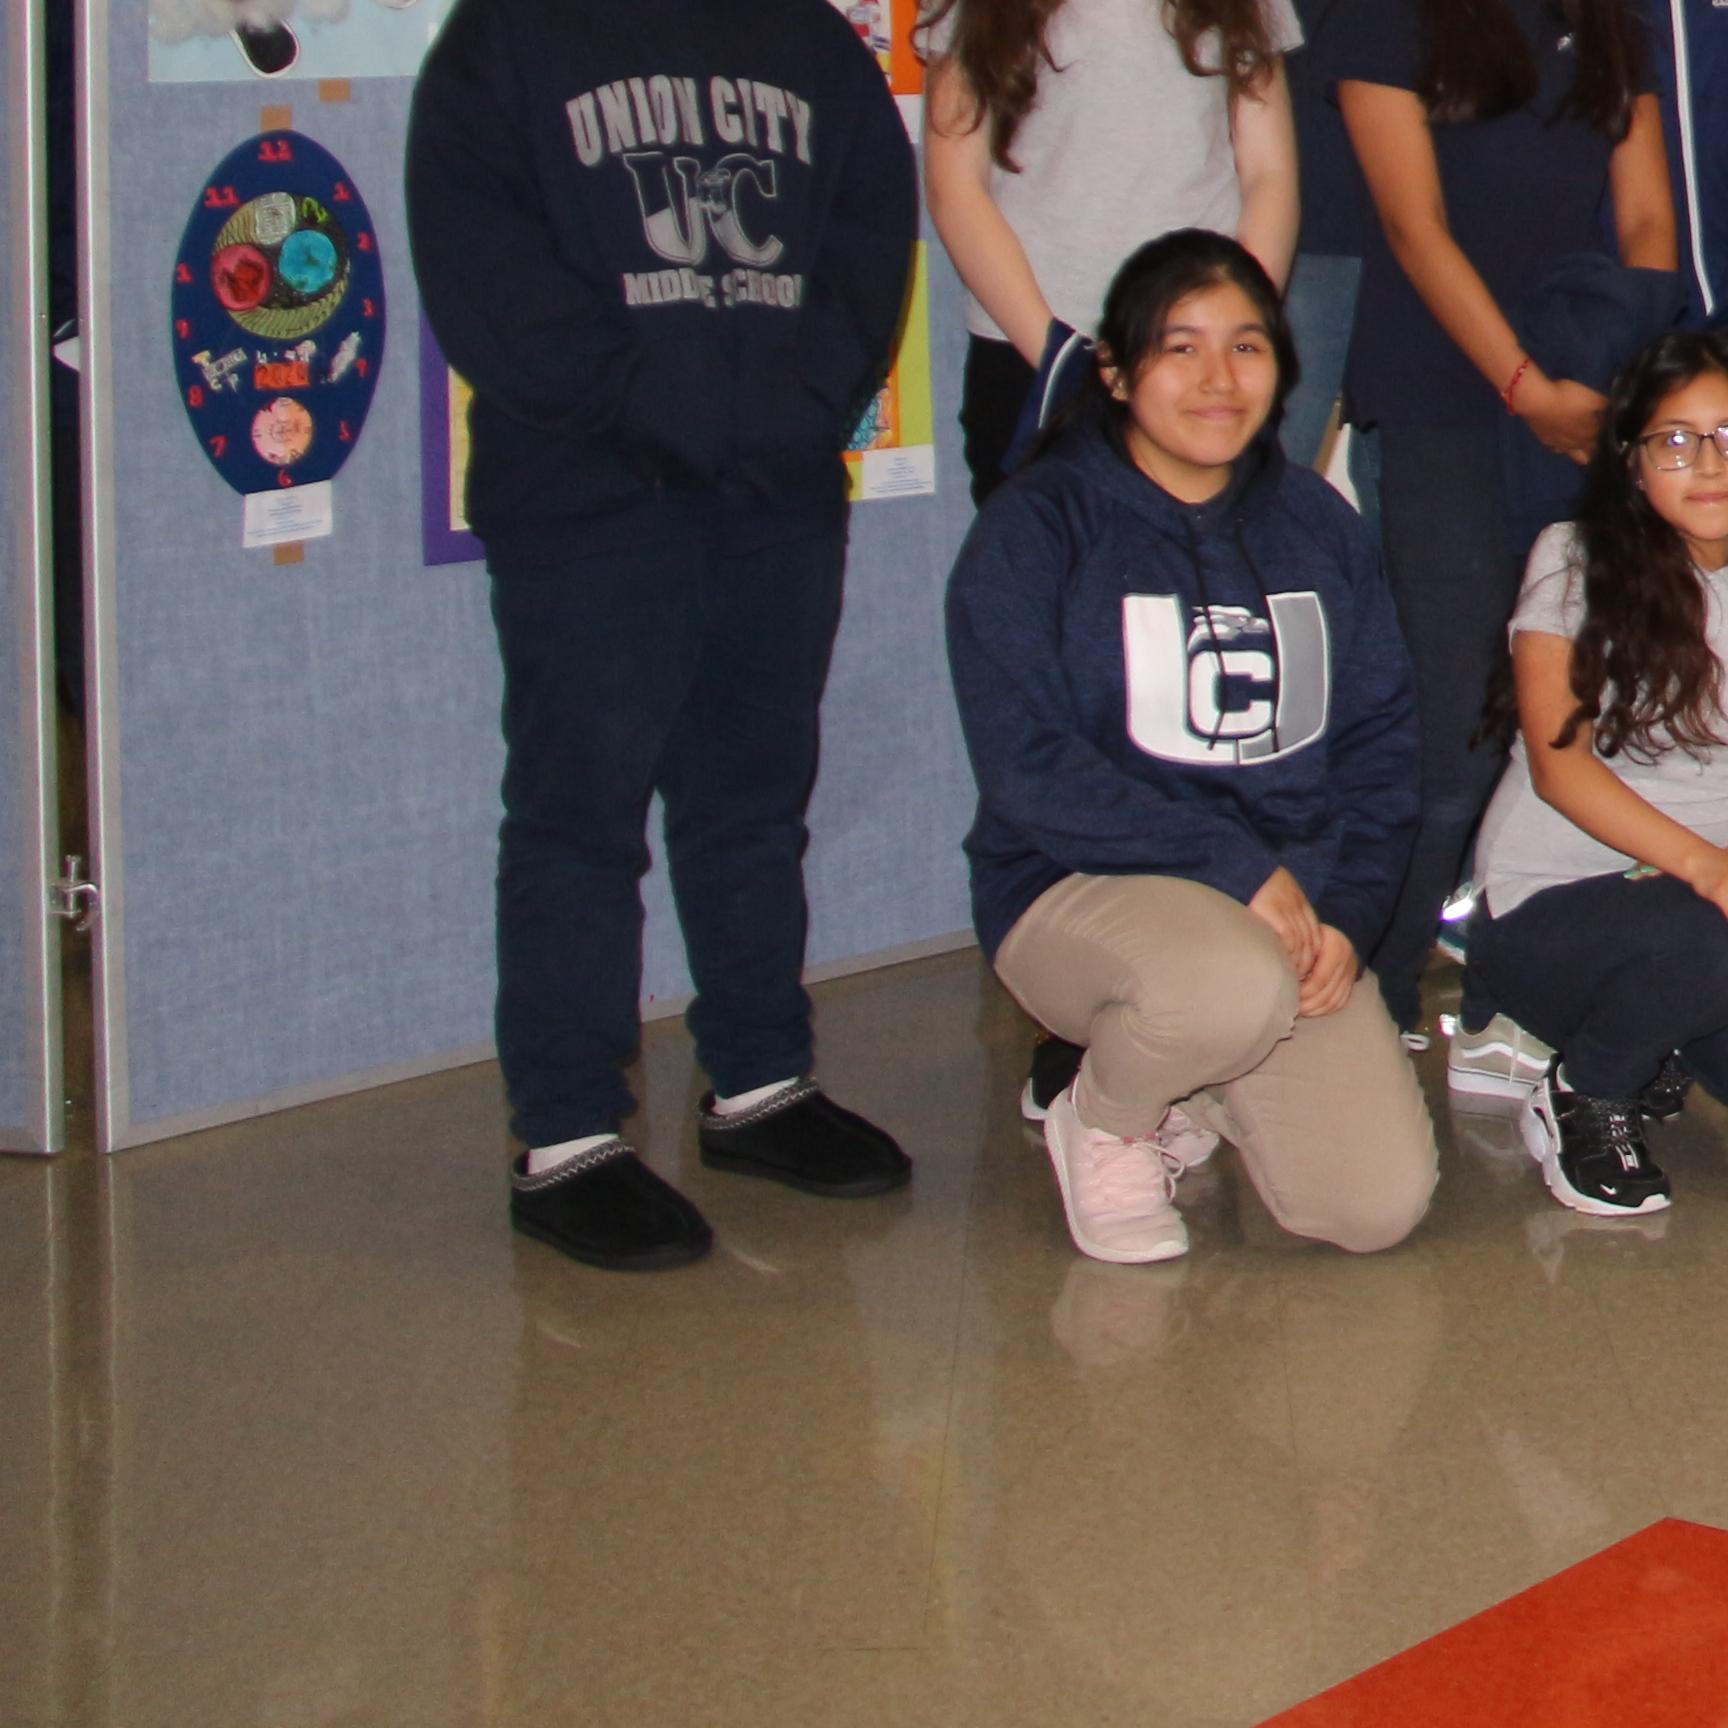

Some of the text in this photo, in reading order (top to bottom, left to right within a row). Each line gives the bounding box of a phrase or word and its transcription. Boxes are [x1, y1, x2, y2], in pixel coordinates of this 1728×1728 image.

[565, 73, 812, 168] UNION CITY
[258, 139, 294, 162] 12
[203, 185, 240, 208] 11
[622, 150, 783, 267] UC
[622, 267, 717, 308] MIDDE
[187, 384, 205, 408] 8
[208, 435, 229, 458] 7
[277, 470, 294, 489] 6
[1121, 589, 1332, 767] UC
